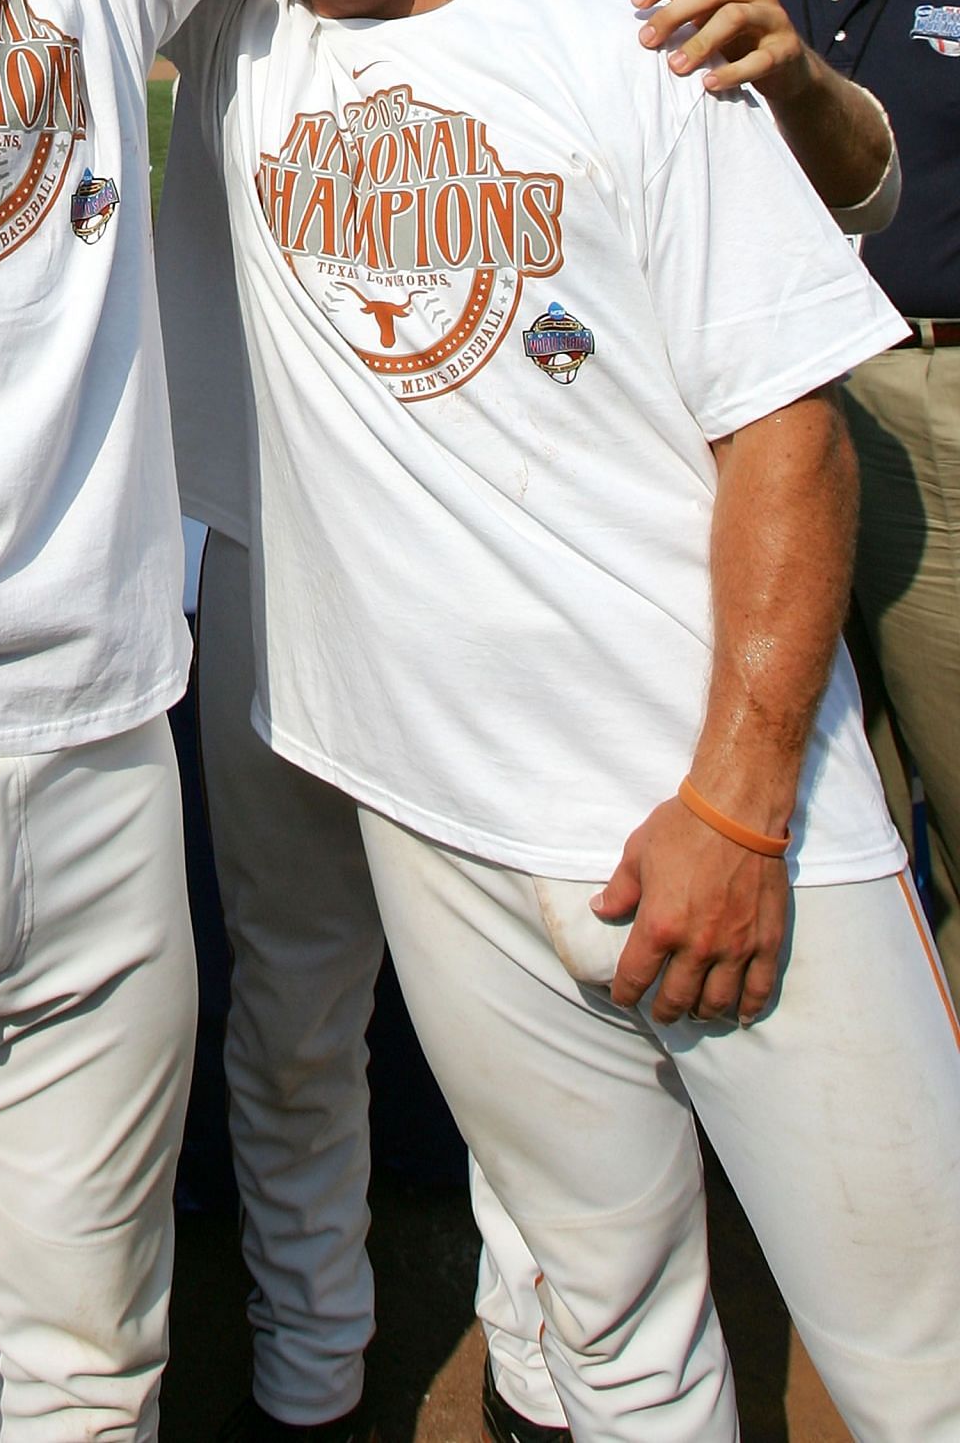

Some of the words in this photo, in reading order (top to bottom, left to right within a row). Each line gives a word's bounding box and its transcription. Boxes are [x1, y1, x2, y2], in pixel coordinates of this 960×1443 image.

[348, 93, 406, 134] 2005
[288, 117, 491, 189] NAIONAL
[401, 370, 449, 394] MEN'S
[446, 308, 504, 380] BASEBALL
